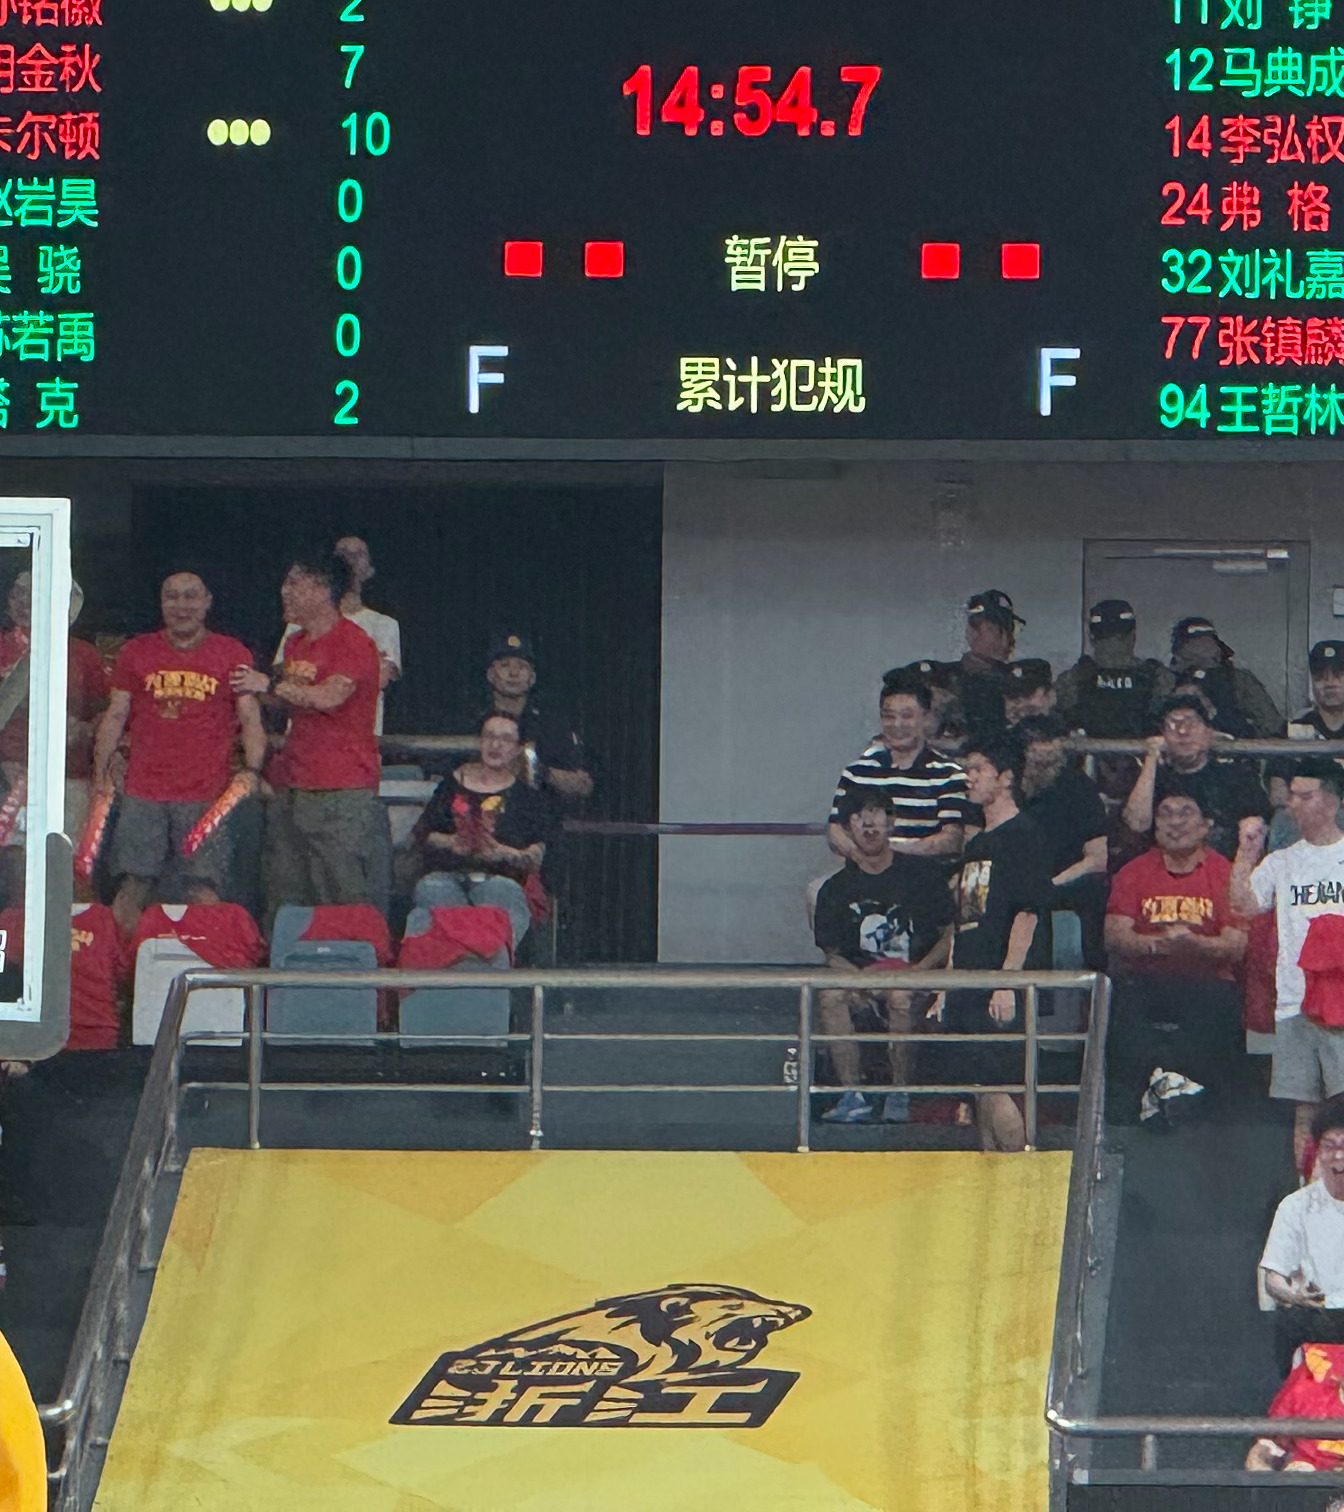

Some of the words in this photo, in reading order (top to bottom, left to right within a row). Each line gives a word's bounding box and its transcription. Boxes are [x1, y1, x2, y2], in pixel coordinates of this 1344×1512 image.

[340, 45, 364, 88] 7
[622, 63, 883, 137] 14:54.7
[342, 112, 390, 156] 10
[338, 178, 362, 222] 0
[336, 246, 361, 290] 0
[724, 234, 820, 293] 暂停
[336, 313, 360, 356] 0
[334, 380, 359, 424] 2
[467, 345, 509, 414] F
[676, 355, 866, 414] 累计犯规
[1037, 347, 1081, 417] F
[410, 1376, 772, 1425] 浙江
